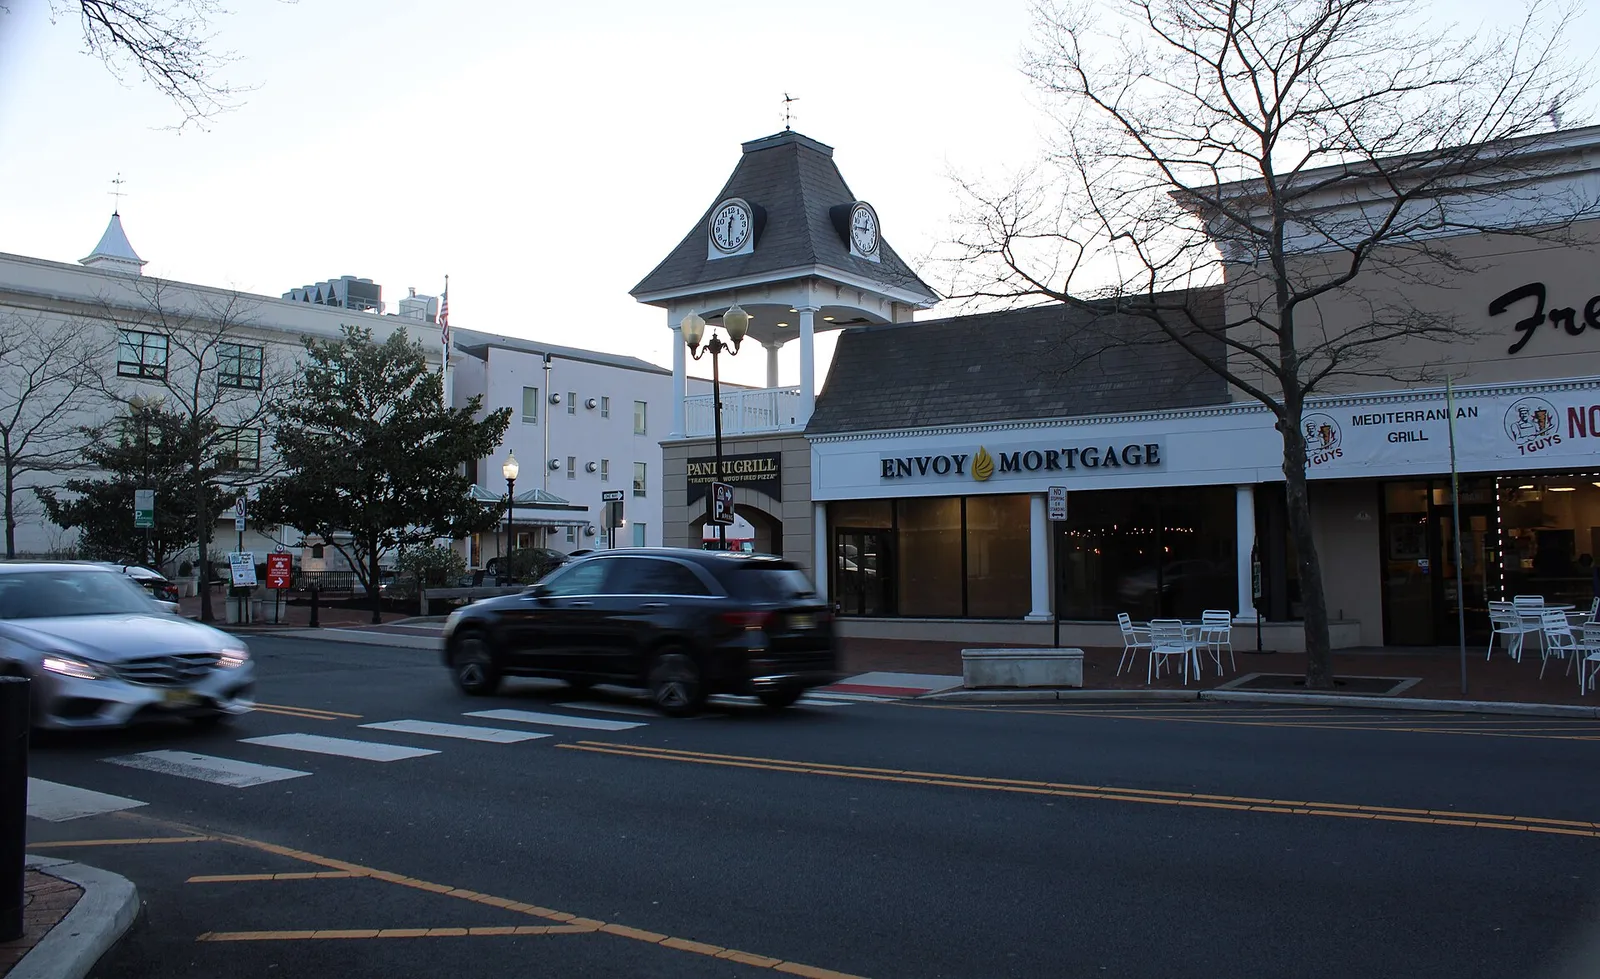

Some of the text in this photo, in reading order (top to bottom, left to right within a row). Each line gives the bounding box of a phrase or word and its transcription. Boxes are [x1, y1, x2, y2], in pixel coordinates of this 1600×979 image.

[717, 218, 725, 226] 10
[1352, 406, 1478, 426] MEDITERRANAN
[1387, 429, 1429, 443] GRILL
[1518, 434, 1562, 455] 7 GUYS
[880, 442, 1161, 479] ENVOY MORTGAGE
[1313, 447, 1343, 465] GUYS
[734, 458, 777, 474] GRILL
[722, 475, 739, 483] WOOD
[740, 474, 757, 482] FIRED
[1053, 488, 1062, 496] NO
